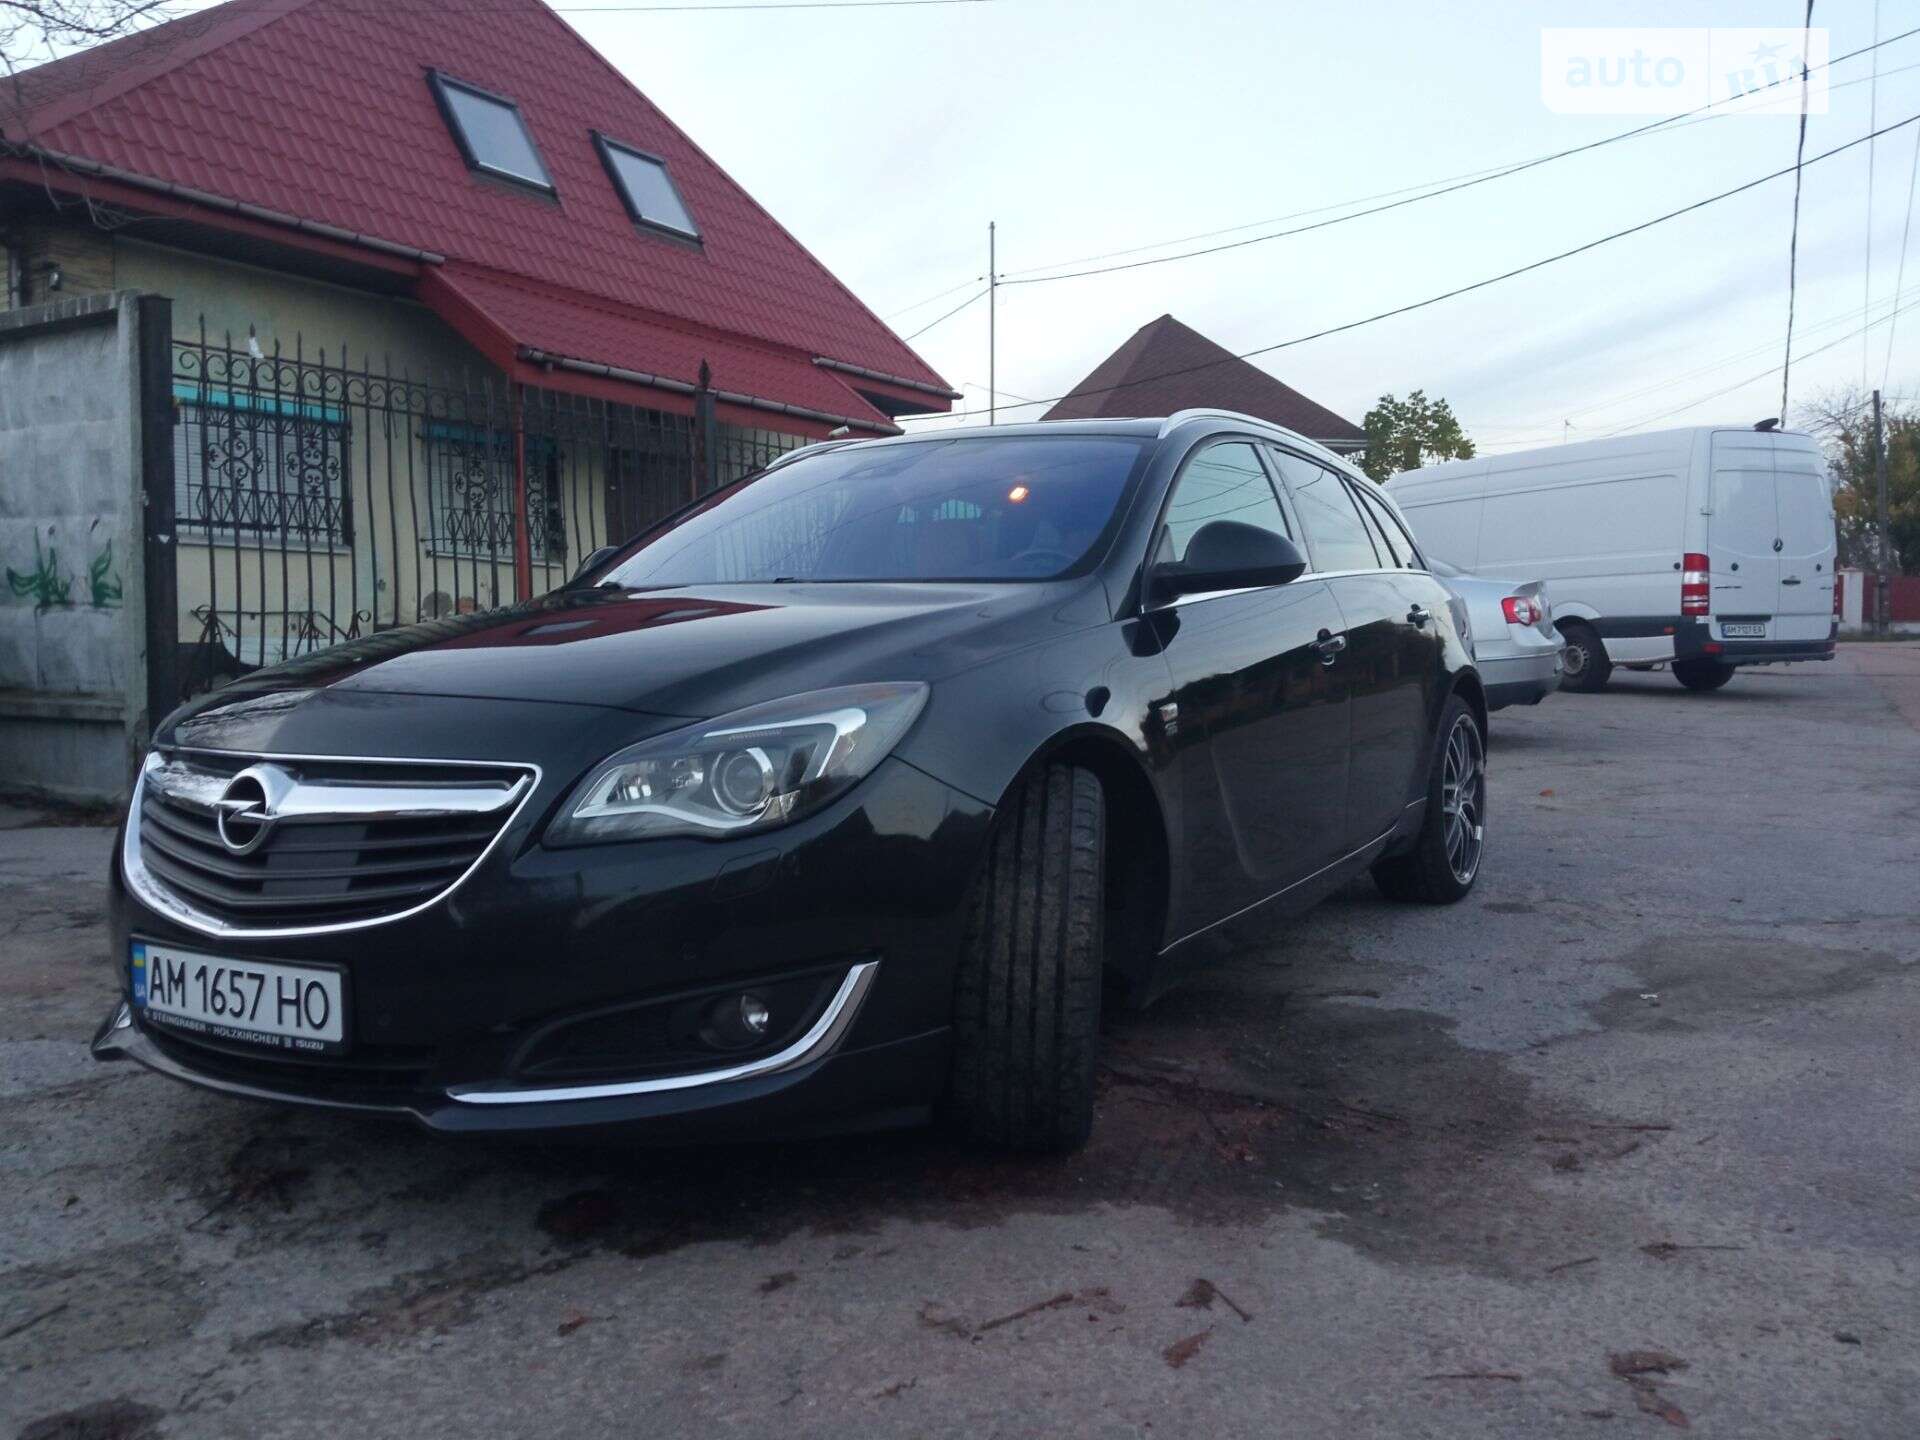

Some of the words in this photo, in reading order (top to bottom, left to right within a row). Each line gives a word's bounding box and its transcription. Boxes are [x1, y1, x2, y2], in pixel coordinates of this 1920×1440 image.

[150, 956, 186, 1008] AM
[195, 965, 265, 1021] 1657
[276, 975, 330, 1031] HO
[213, 1027, 279, 1045] HOLZKIRCHEN
